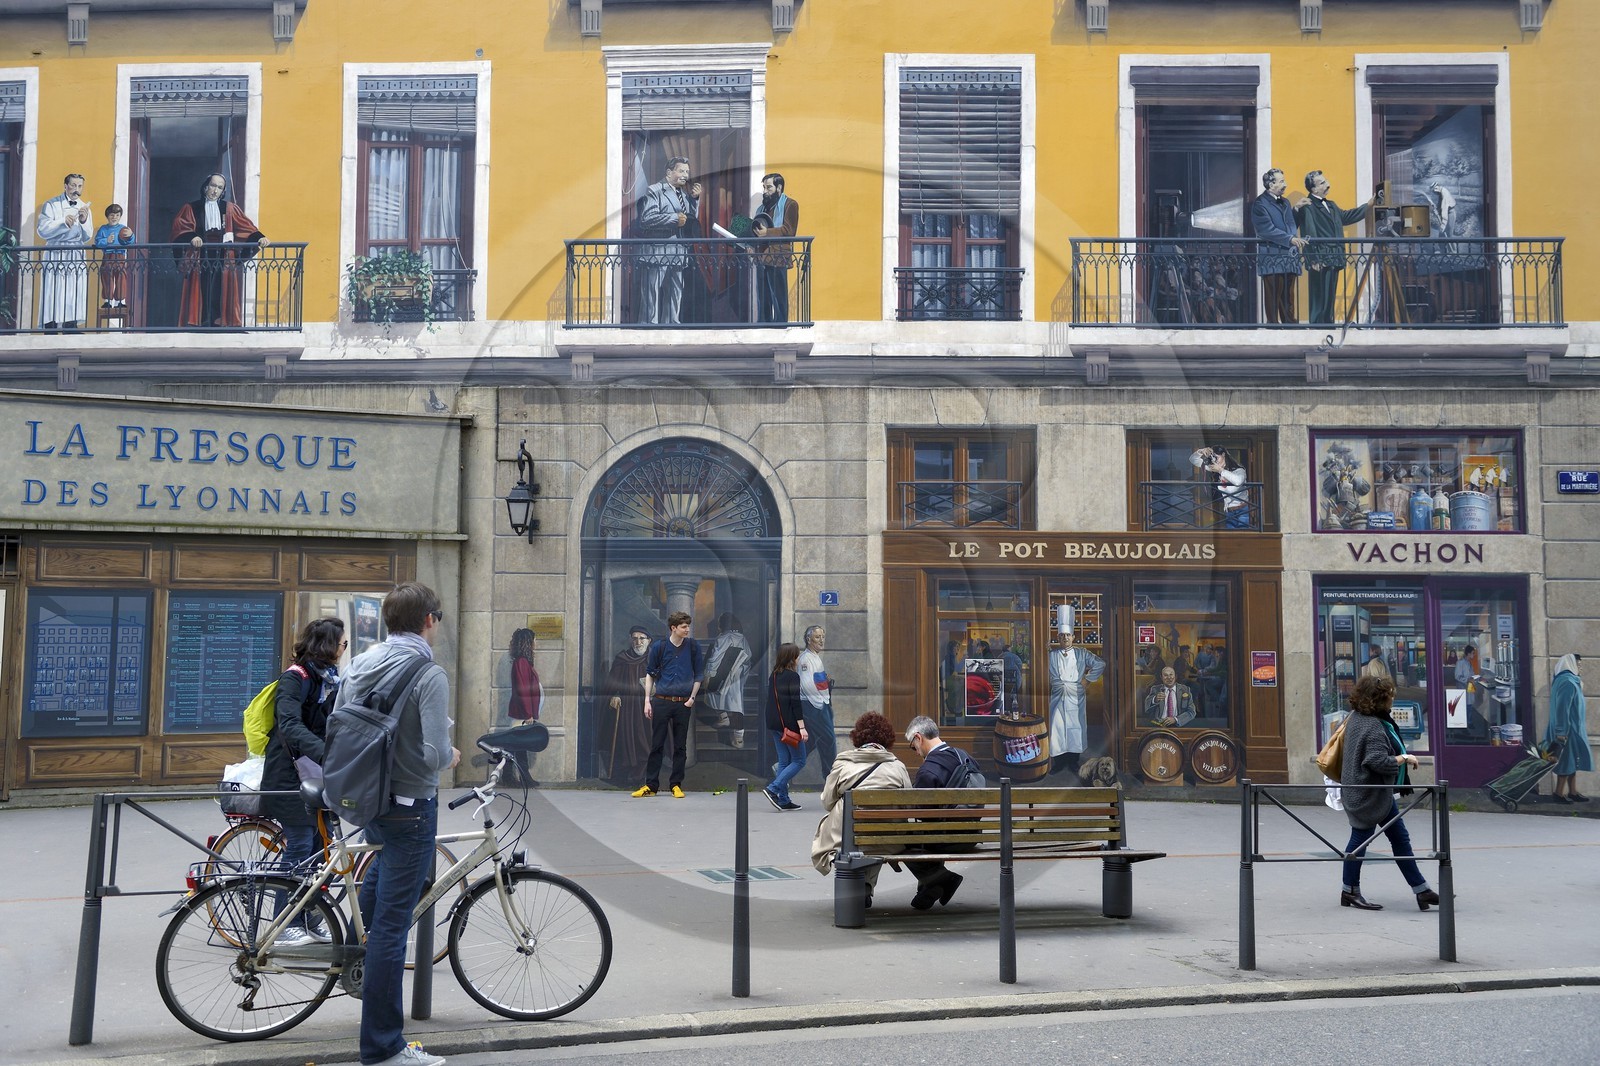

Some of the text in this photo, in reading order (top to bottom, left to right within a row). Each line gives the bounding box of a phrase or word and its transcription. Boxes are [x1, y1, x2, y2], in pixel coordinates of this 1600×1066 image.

[24, 420, 358, 471] LA FRESQUE
[21, 479, 357, 516] DES LYONNAIS
[948, 542, 1217, 560] LE POT BEAUJOLAIS
[1346, 542, 1484, 564] VACHON
[825, 593, 833, 604] 2
[1147, 742, 1177, 755] BEAUJOLAIS
[1199, 740, 1229, 752] BEAUJOLAIS
[1202, 762, 1228, 774] VILLAGES
